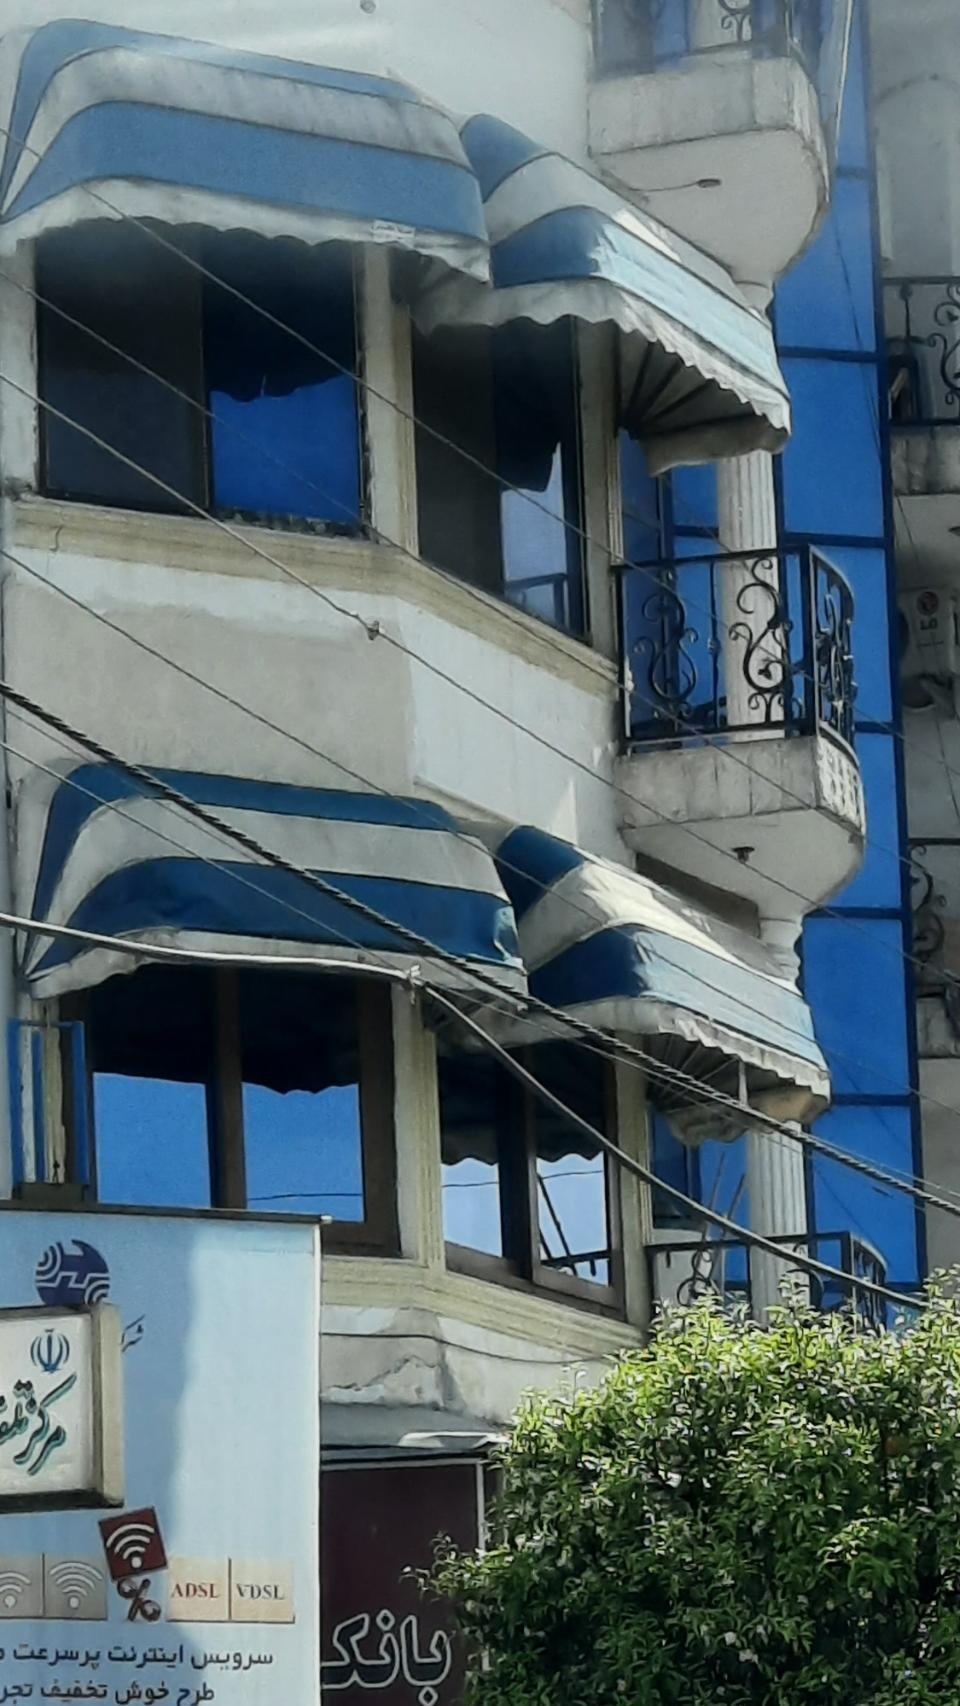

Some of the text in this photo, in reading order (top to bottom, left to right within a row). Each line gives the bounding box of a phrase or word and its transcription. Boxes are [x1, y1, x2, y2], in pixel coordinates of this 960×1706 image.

[12, 1371, 78, 1477] مرکز
[171, 1581, 220, 1599] ADSL
[235, 1583, 286, 1601] VDSL
[12, 1643, 100, 1671] پرسرعت
[107, 1644, 184, 1669] اینترنت
[190, 1649, 275, 1671] سرویس
[39, 1678, 108, 1704] تخفیف
[114, 1680, 171, 1706] خوش
